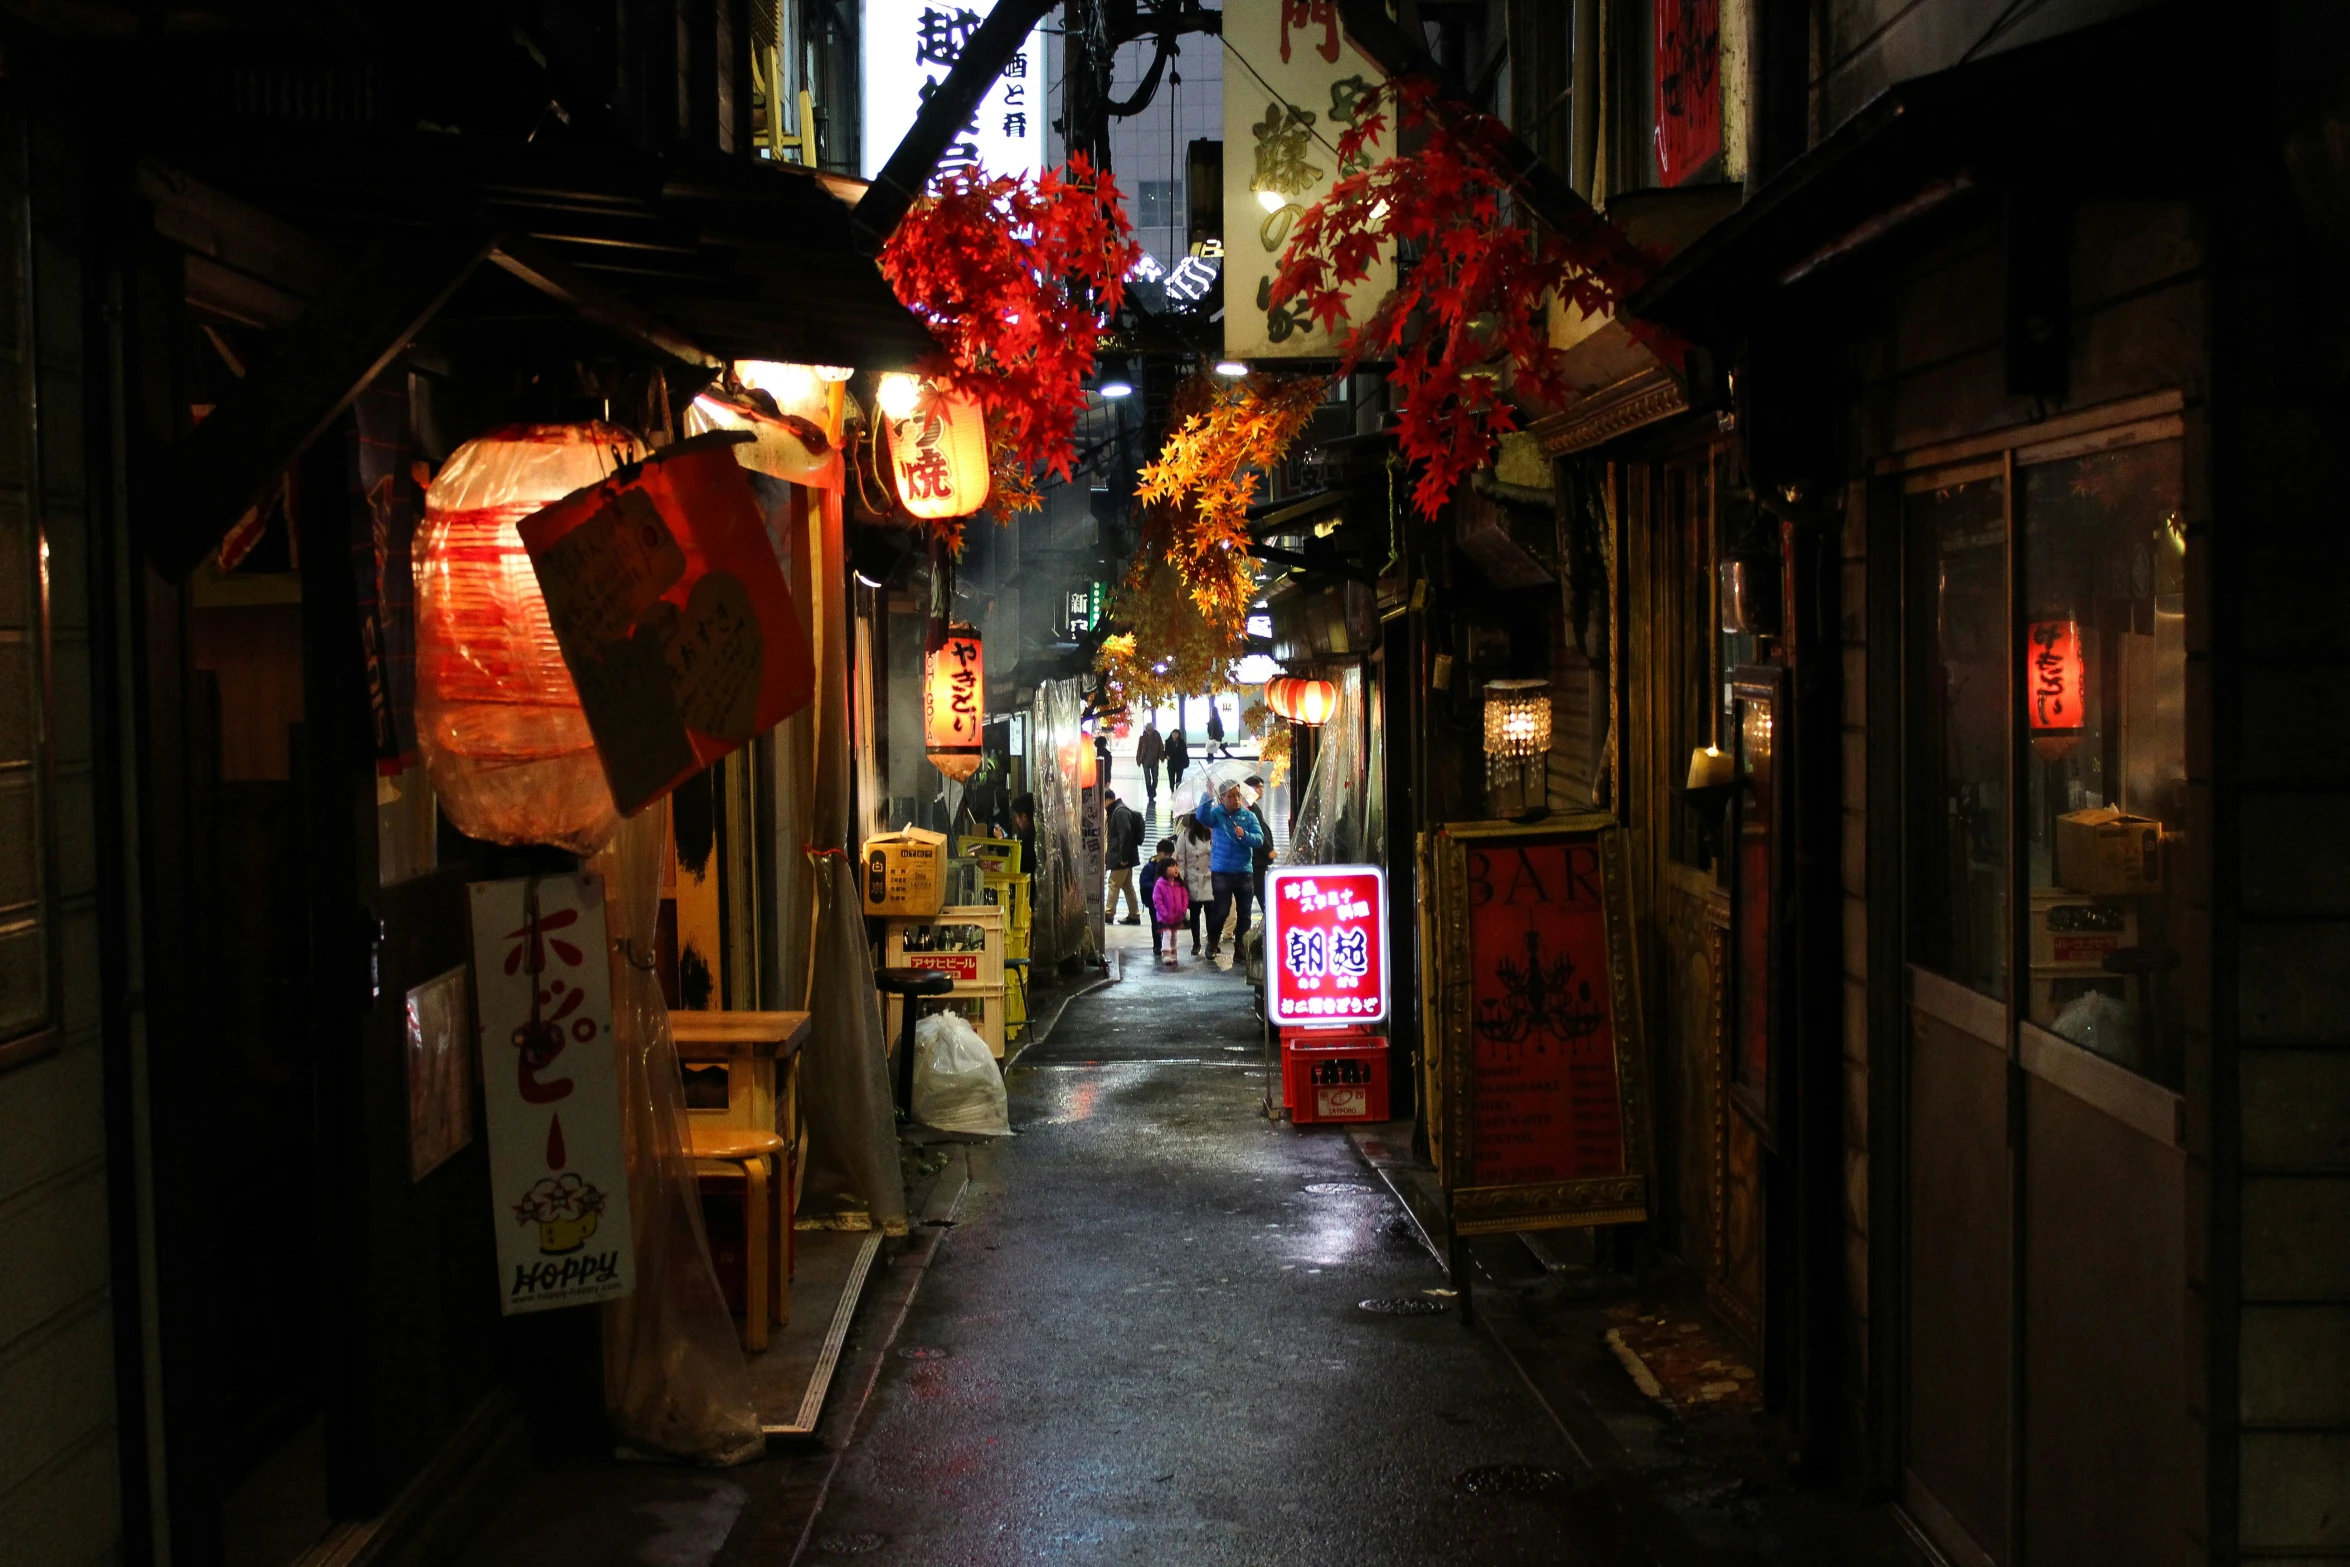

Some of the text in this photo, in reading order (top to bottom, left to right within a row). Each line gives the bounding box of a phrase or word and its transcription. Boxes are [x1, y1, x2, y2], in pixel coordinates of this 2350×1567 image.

[926, 654, 934, 741] CHIGOYA
[951, 641, 977, 742] やきとり
[1468, 845, 1601, 906] BAR
[911, 957, 975, 969] アサヒビール
[511, 1250, 619, 1296] Hoppy
